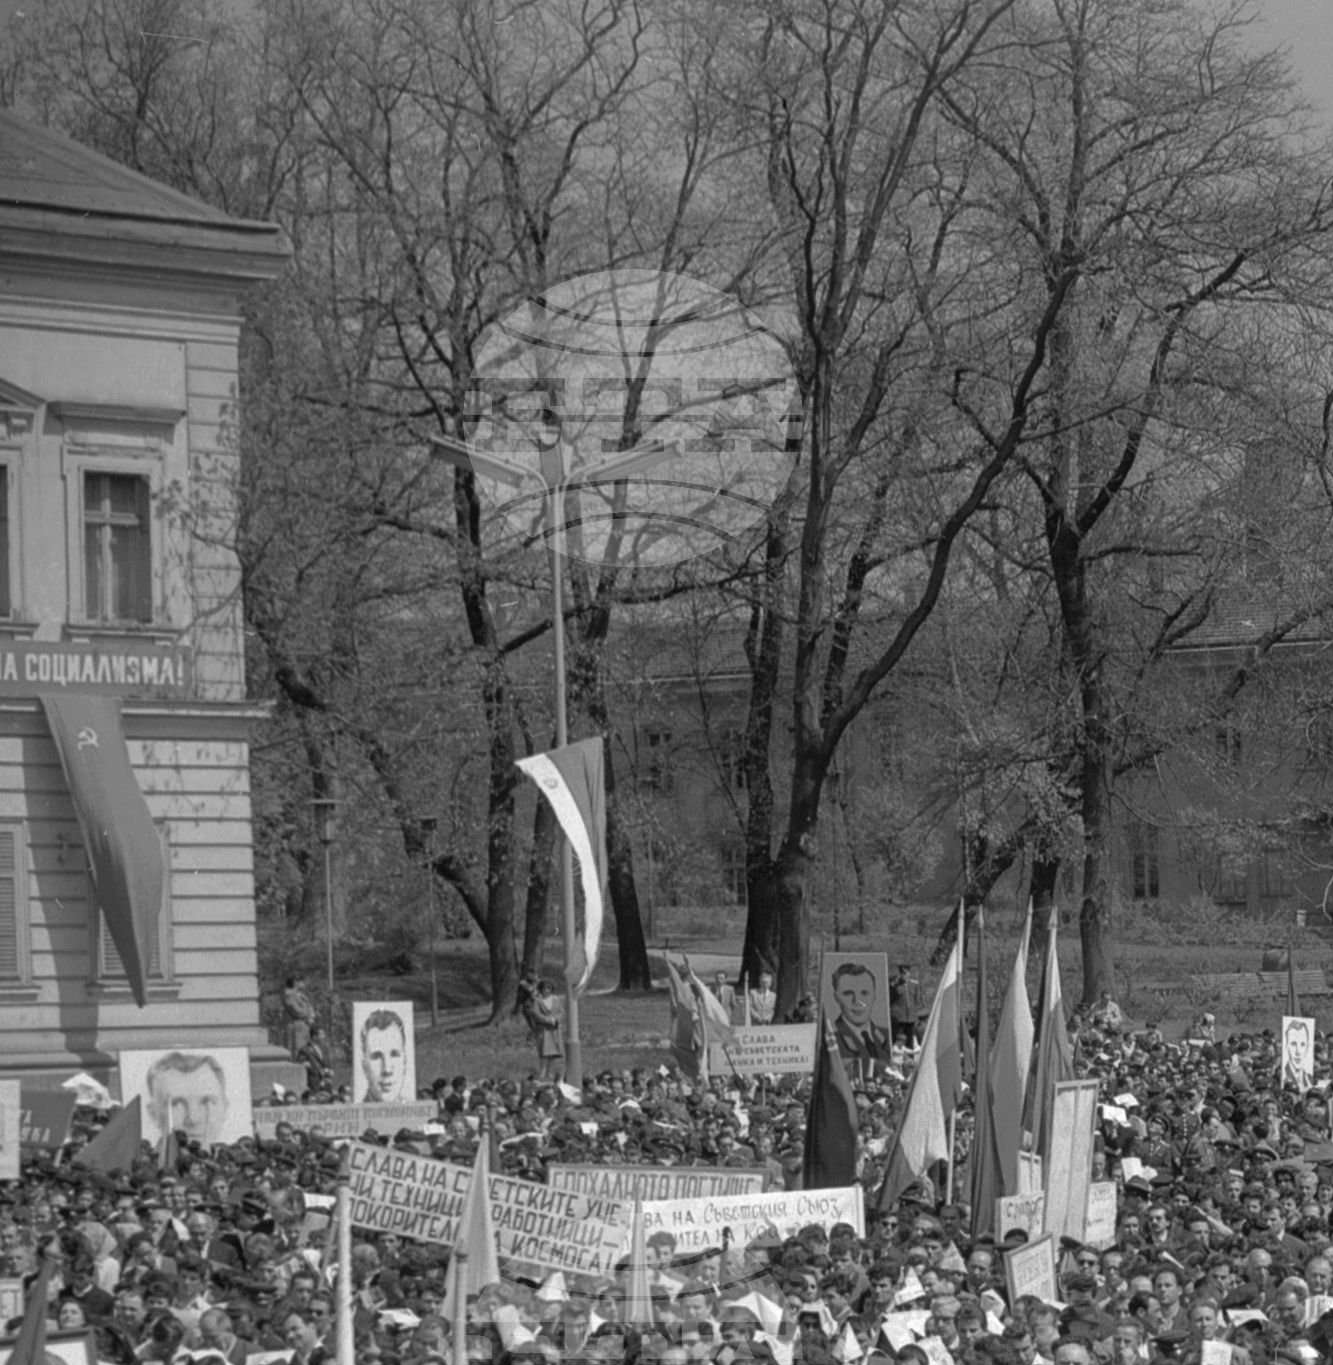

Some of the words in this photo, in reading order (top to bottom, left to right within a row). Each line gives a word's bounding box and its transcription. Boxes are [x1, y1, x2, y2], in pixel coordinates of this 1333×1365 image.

[25, 653, 184, 686] СОЦИАЛИЗМА!
[351, 1147, 417, 1183] СЛАВА
[421, 1163, 447, 1189] НА
[453, 1170, 579, 1217] СЕТСКИТЕ
[672, 1210, 695, 1226] НА
